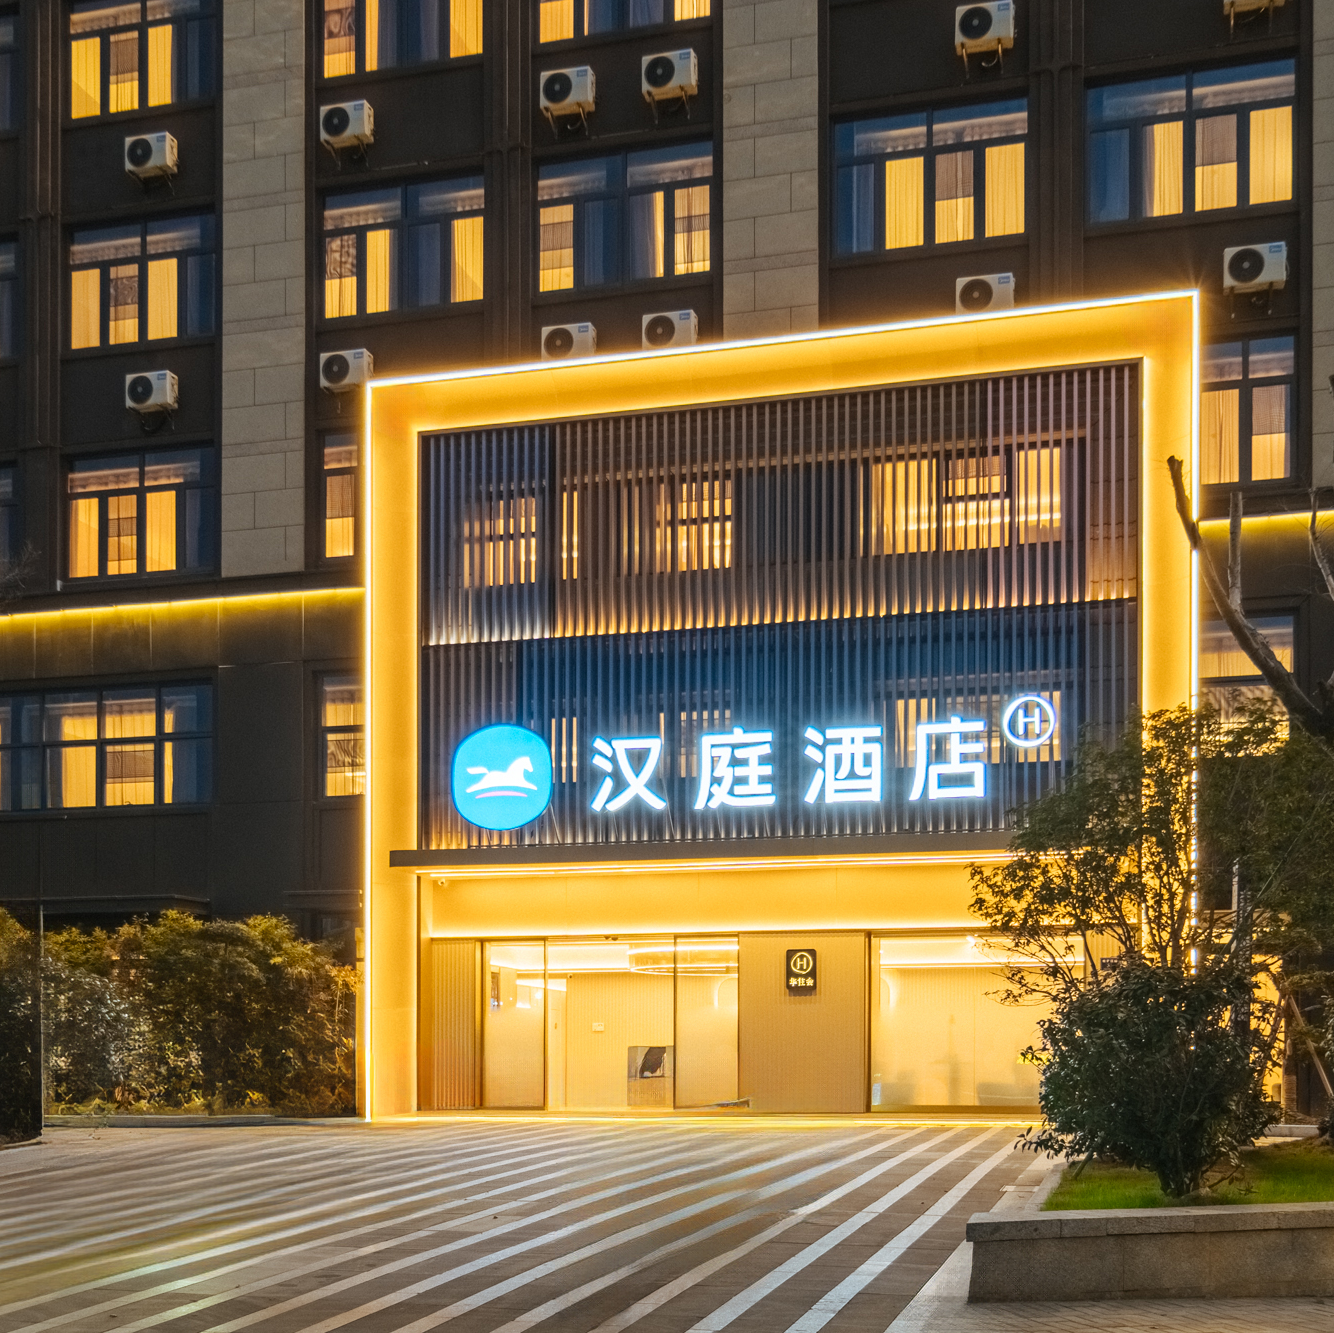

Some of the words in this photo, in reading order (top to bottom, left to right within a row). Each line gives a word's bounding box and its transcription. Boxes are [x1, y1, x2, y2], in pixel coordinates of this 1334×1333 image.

[590, 715, 986, 812] 汉庭酒店
[789, 977, 814, 987] 华住会
